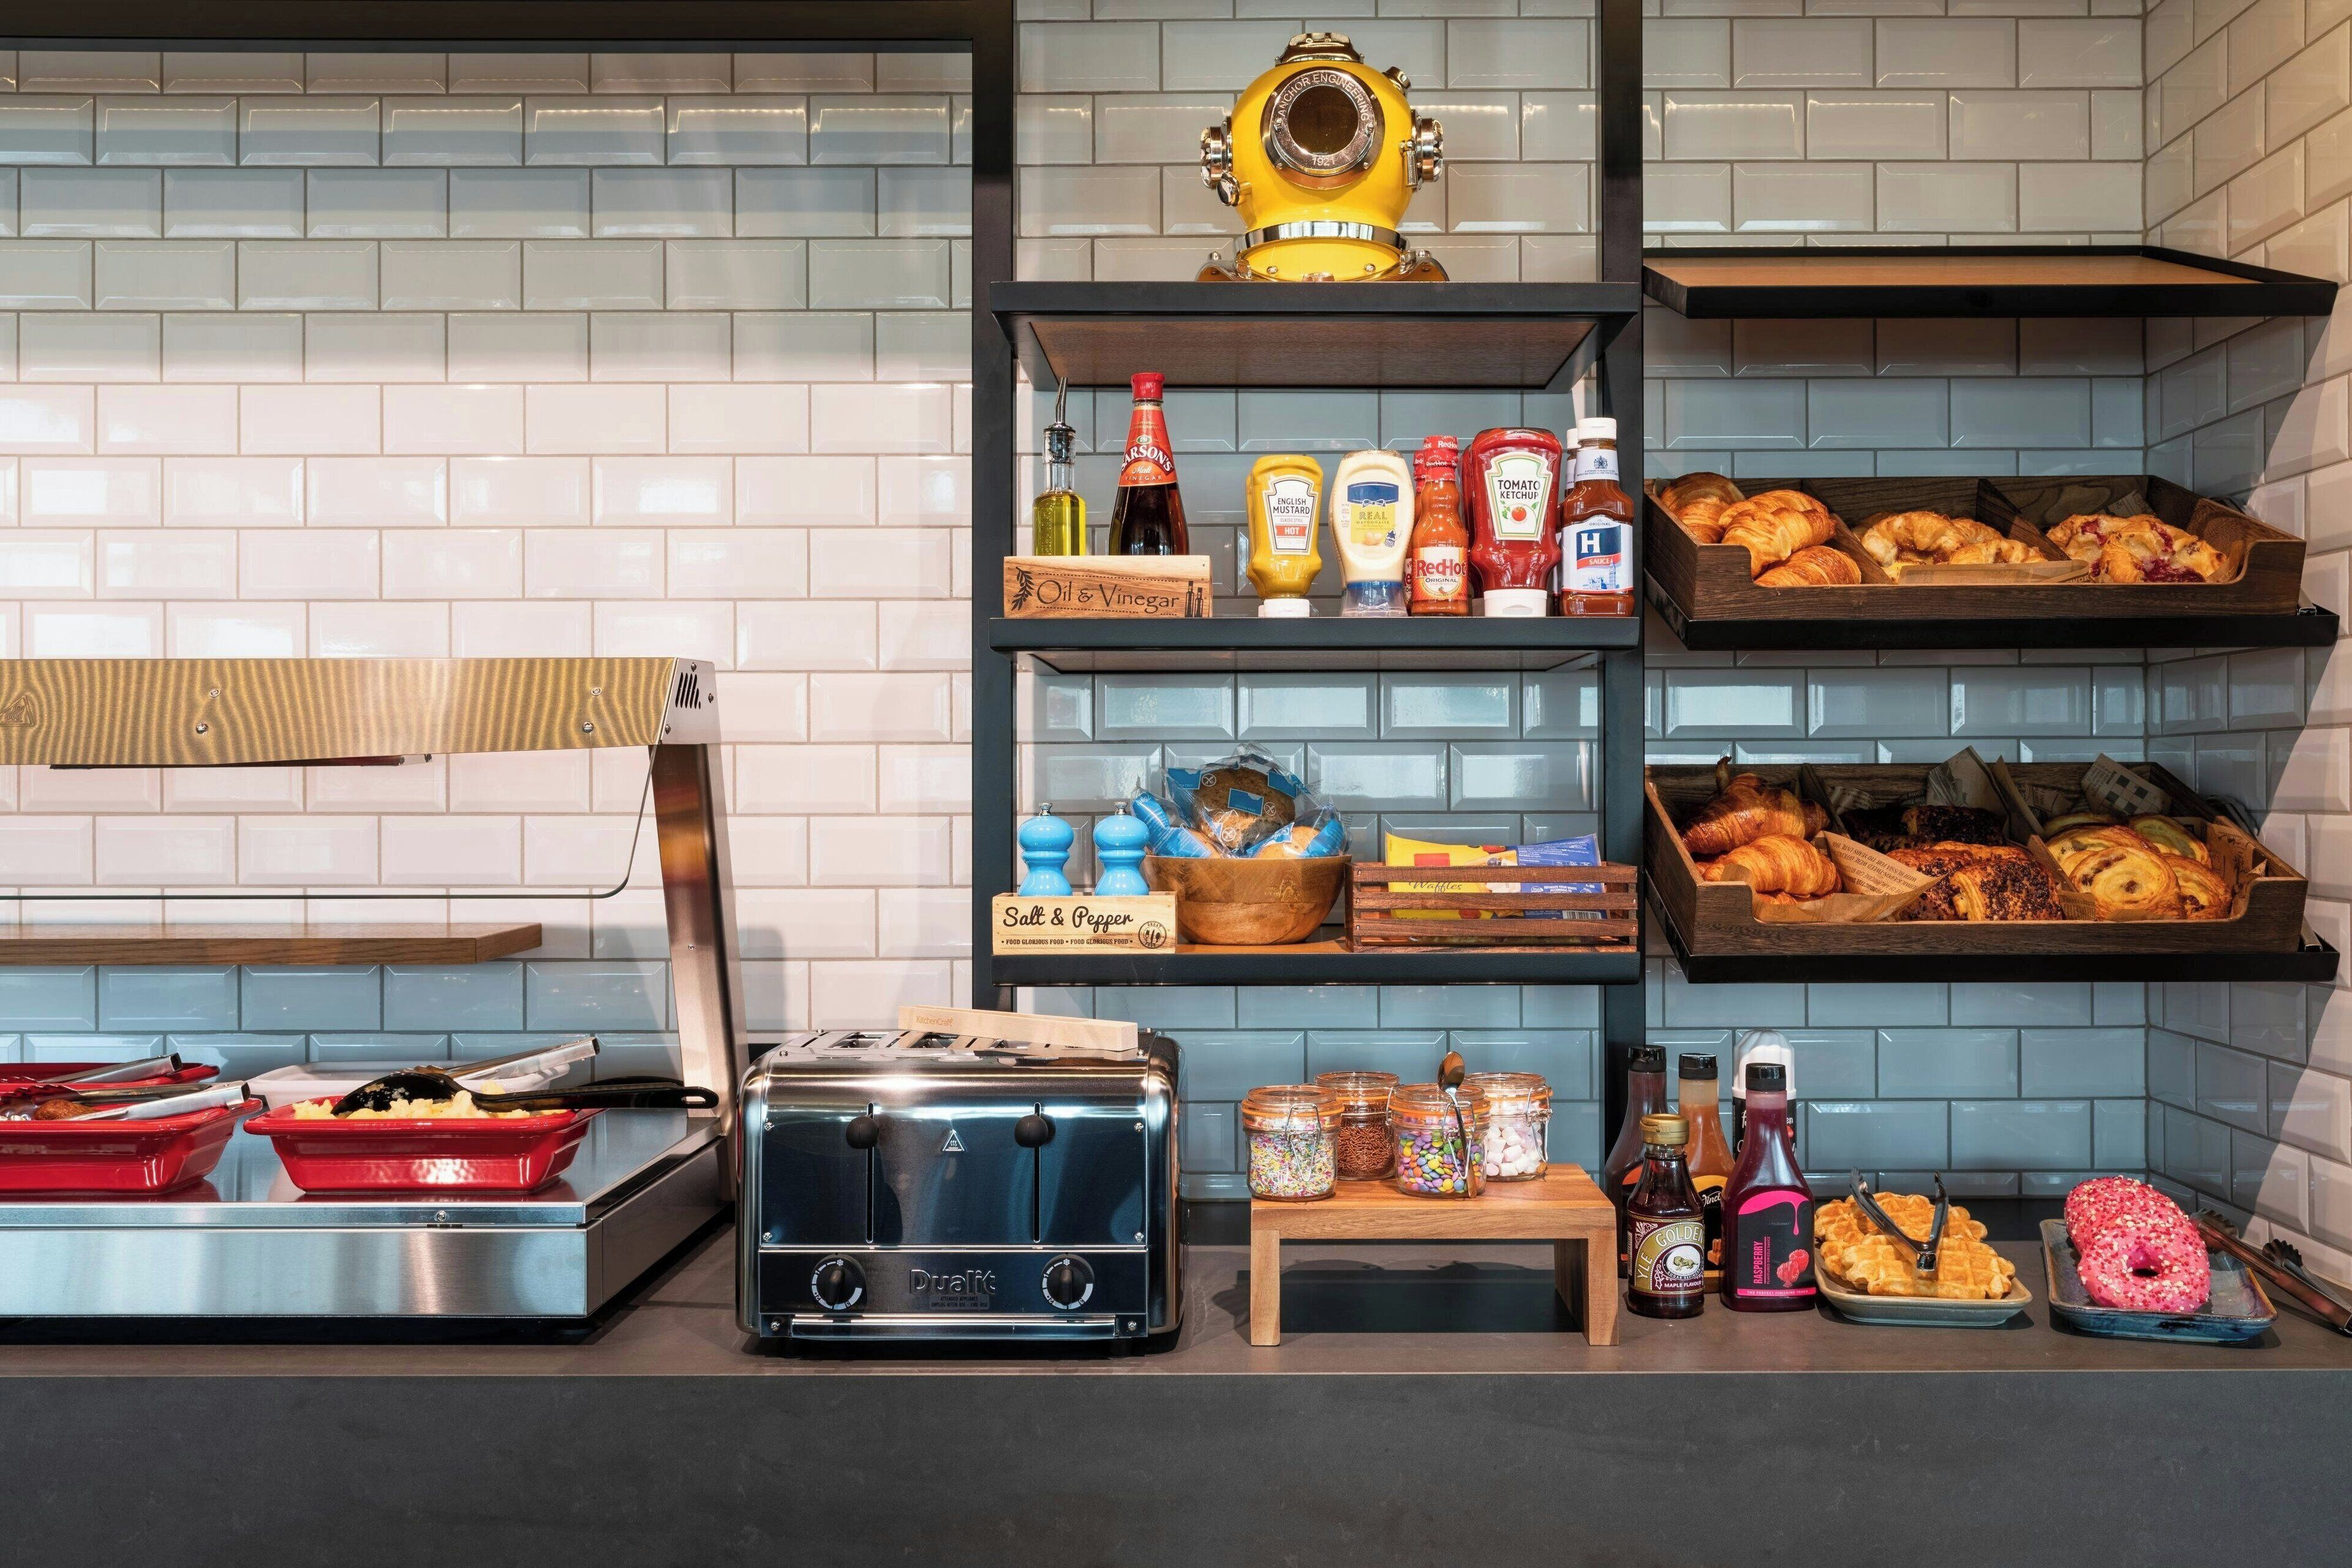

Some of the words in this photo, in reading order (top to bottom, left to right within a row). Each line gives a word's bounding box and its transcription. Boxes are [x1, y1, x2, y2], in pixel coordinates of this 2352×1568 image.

[1278, 77, 1311, 117] ANCHOR
[1313, 74, 1370, 121] ENGINEERING
[1312, 157, 1335, 166] 1921
[1132, 466, 1152, 474] Malt
[1498, 480, 1540, 490] TOMATO
[1500, 491, 1539, 499] KETCHUP
[1359, 511, 1387, 520] REAL
[1037, 580, 1072, 604] Oil
[1078, 588, 1093, 603] &
[1099, 584, 1180, 613] Vinegar
[1003, 905, 1046, 927] Salt
[1050, 907, 1064, 925] &
[1072, 906, 1133, 933] Pepper
[916, 1016, 953, 1027] KitchenCraft
[1655, 1226, 1703, 1248] GOLDEN
[1753, 1241, 1763, 1284] RASPBERRY
[909, 1269, 996, 1295] Dualit
